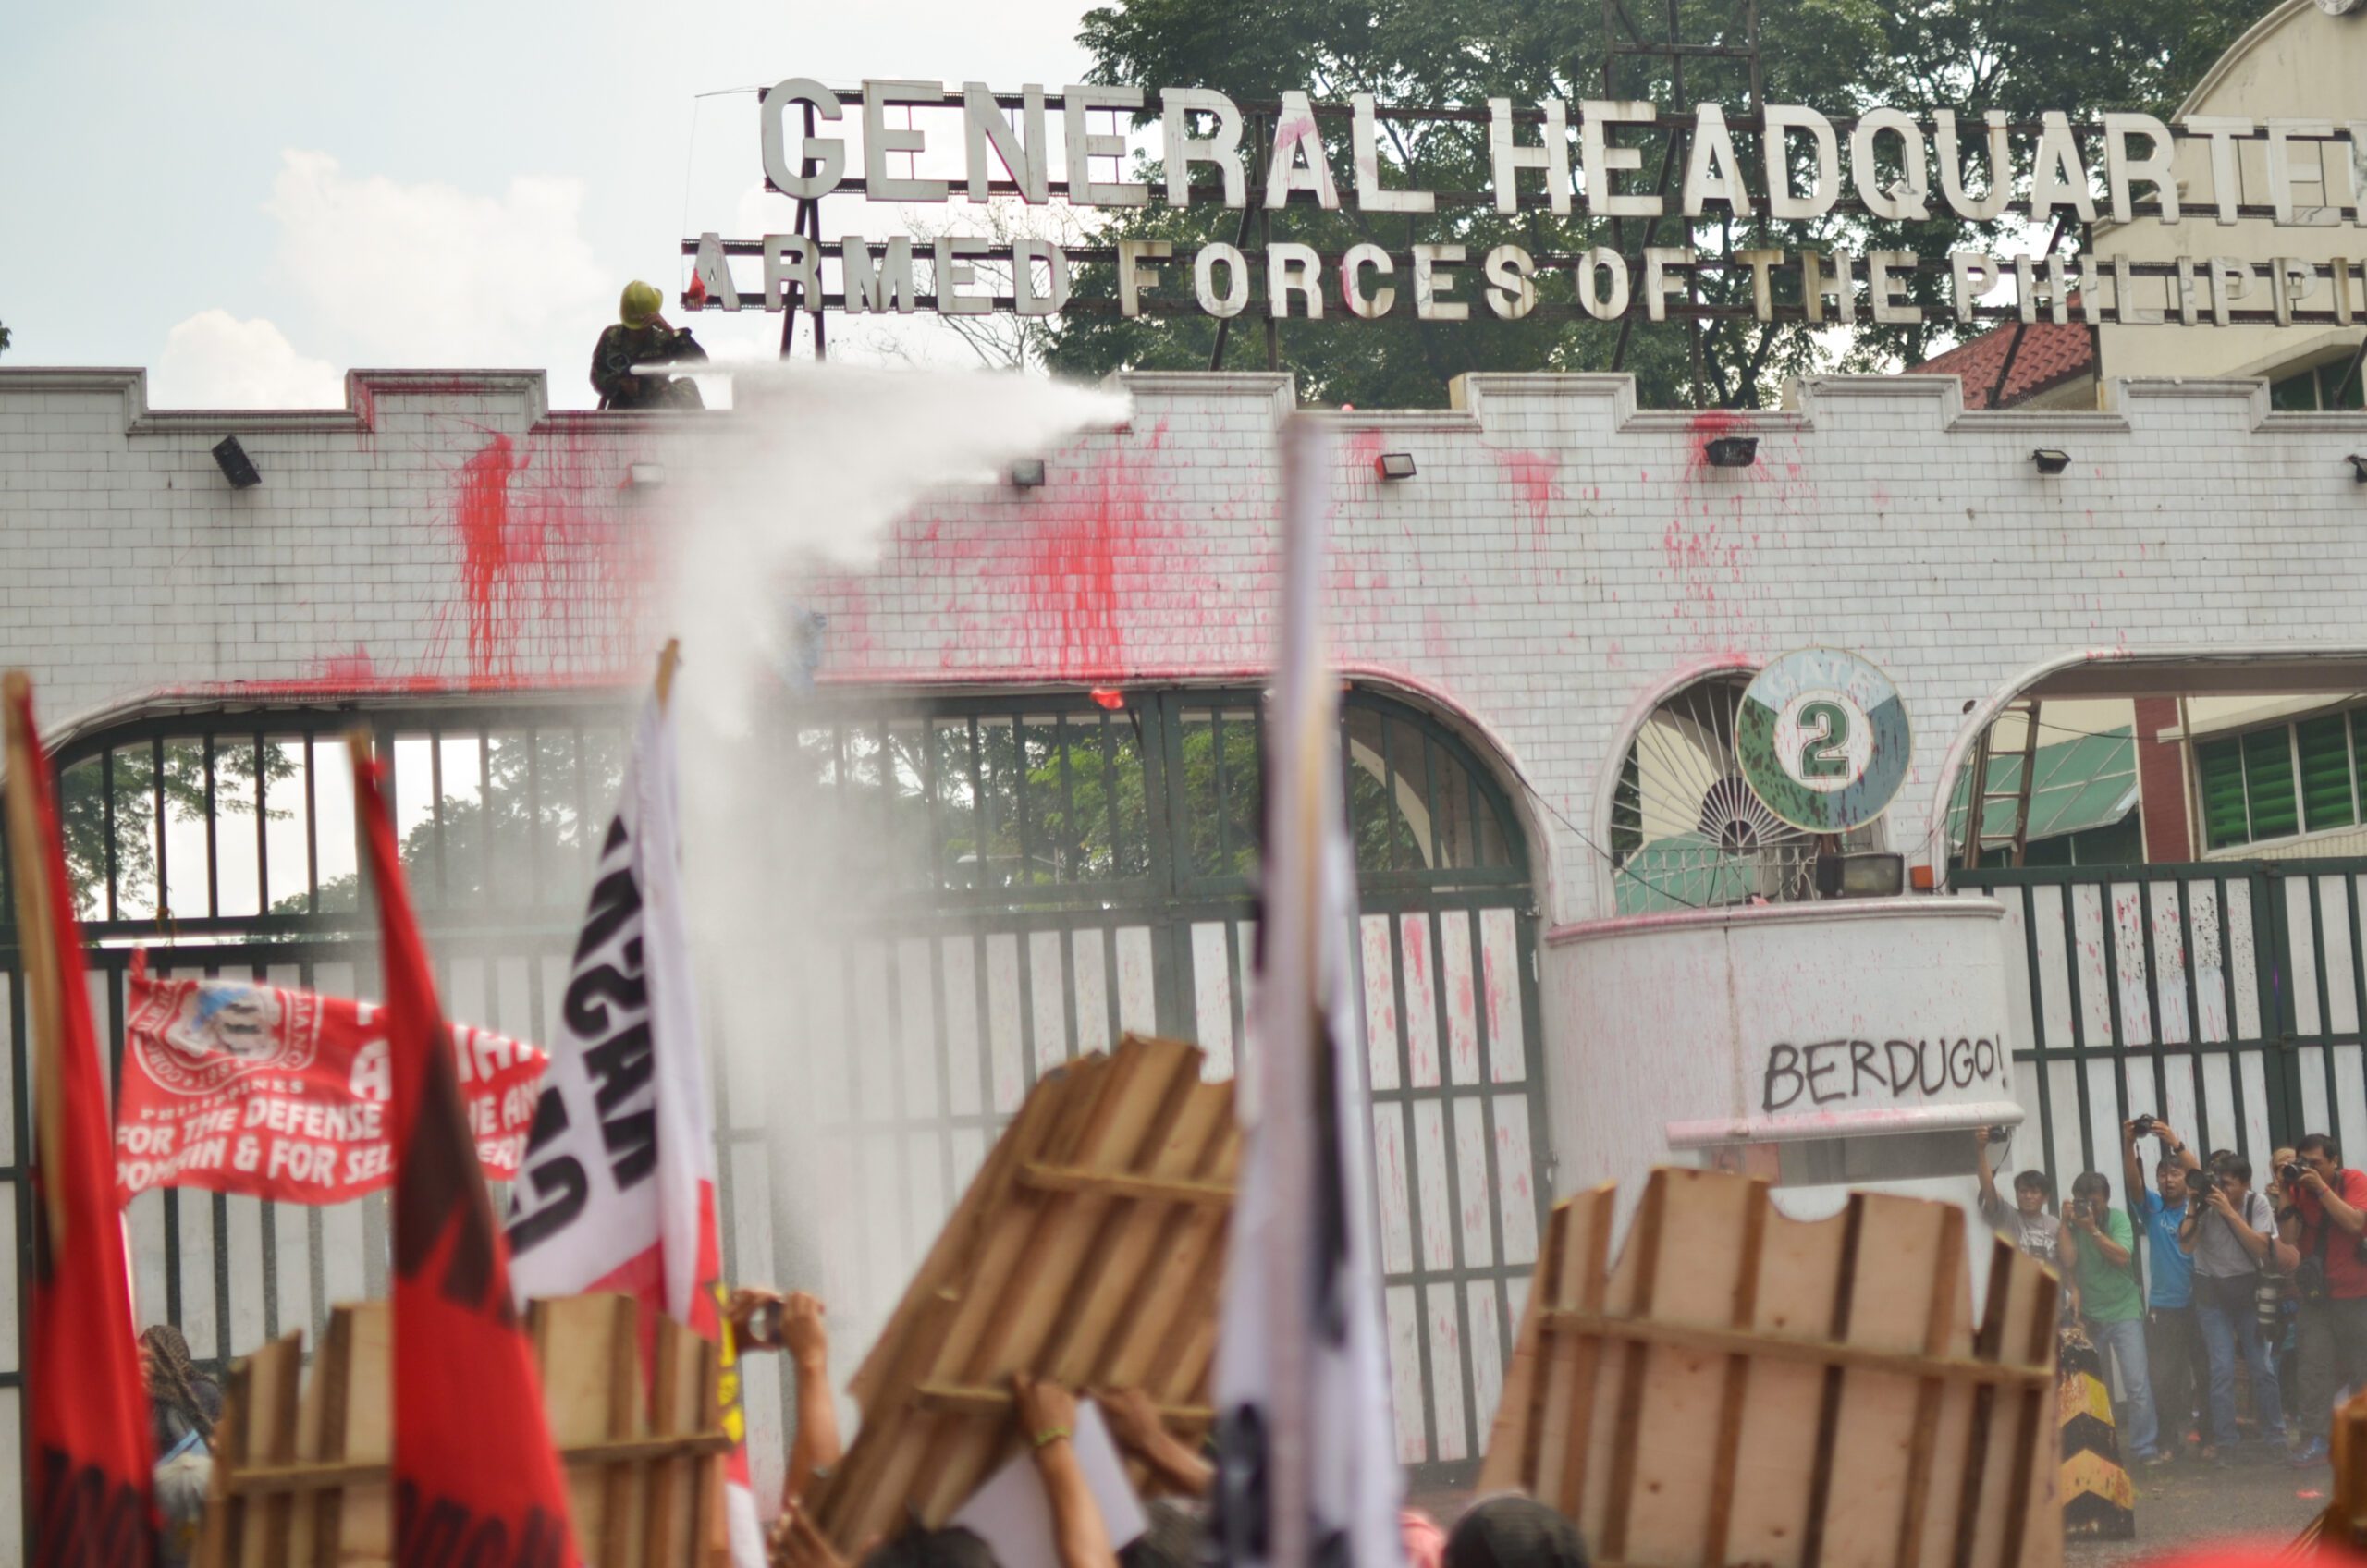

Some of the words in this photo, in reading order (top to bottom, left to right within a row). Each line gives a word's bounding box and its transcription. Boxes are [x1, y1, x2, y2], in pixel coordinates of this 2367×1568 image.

[760, 78, 1436, 214] GENERAL
[1488, 96, 2367, 228] HEADQUARTE
[682, 232, 1070, 318] ARMED
[1117, 239, 1538, 321] FORCES
[1576, 245, 1696, 323] OF
[1734, 247, 1923, 325] THE
[1953, 251, 2367, 327] PHILIPPI
[1765, 654, 1882, 697] GATE
[1797, 700, 1850, 780] 2
[1761, 1033, 2008, 1112] BERDUGO!
[116, 1124, 176, 1156] FOR
[183, 1107, 240, 1145] THE
[242, 1096, 385, 1143] DEFENSE
[234, 1133, 261, 1172] &
[267, 1138, 337, 1189] FOR
